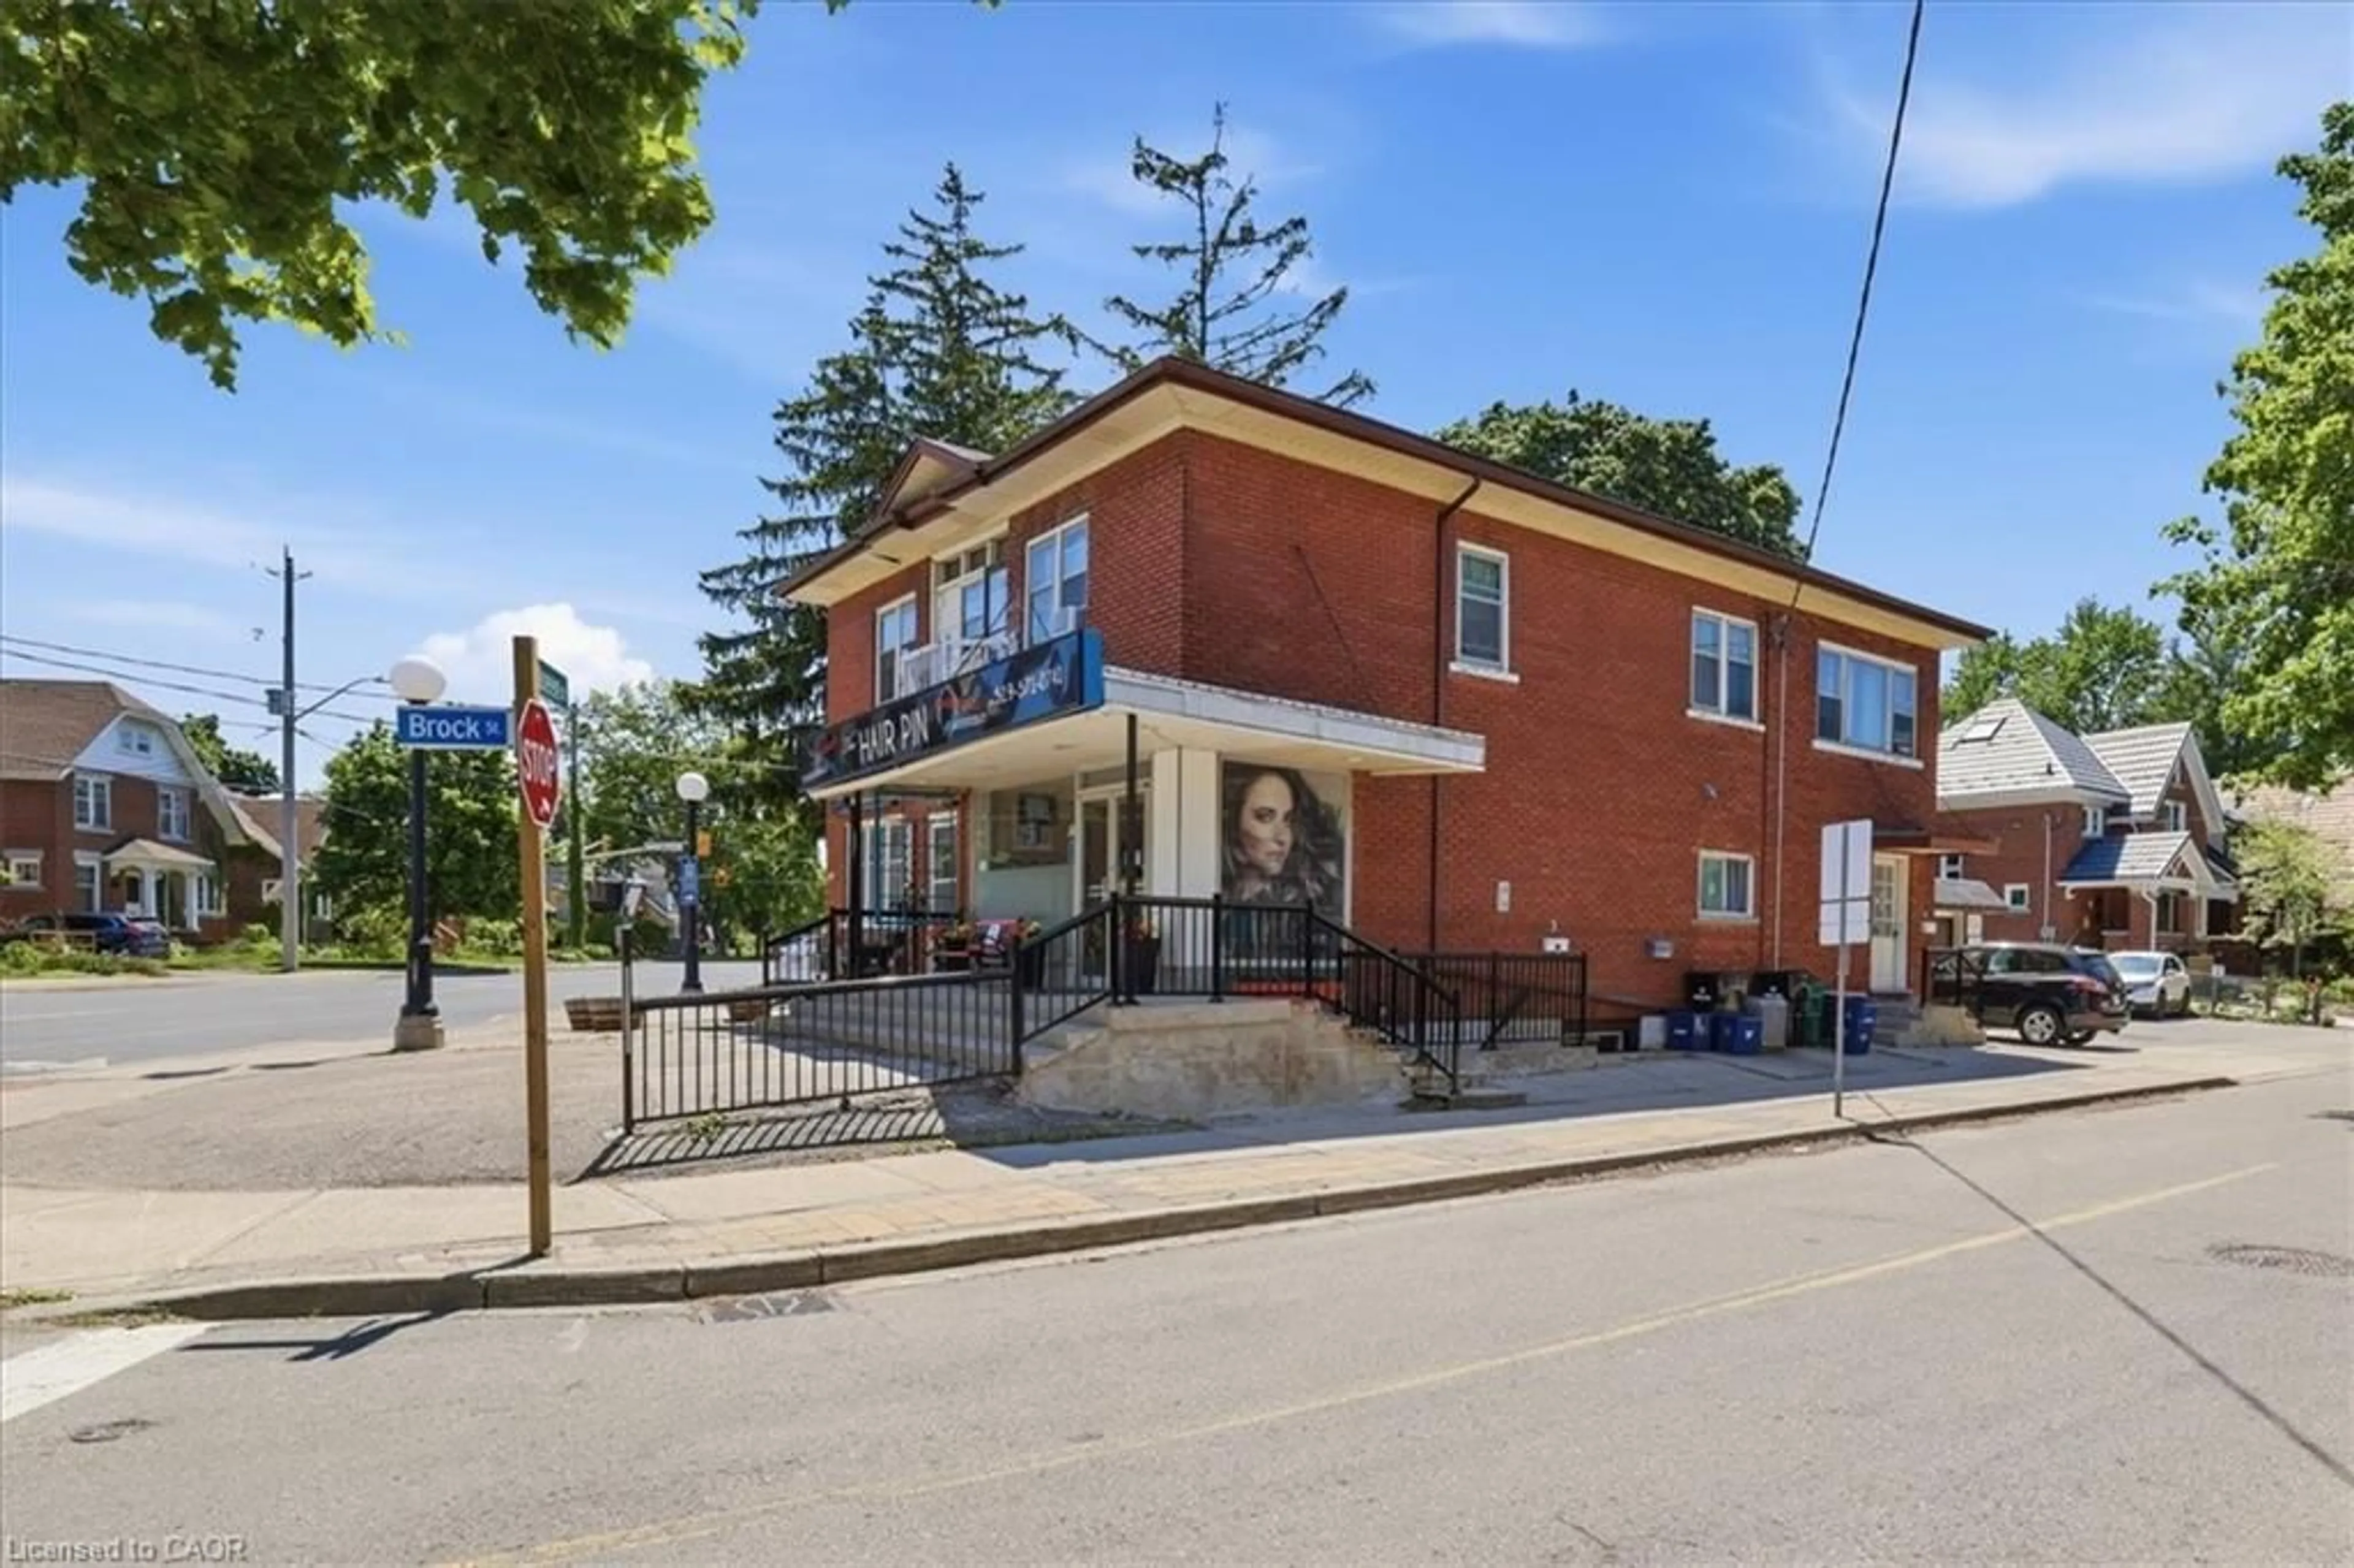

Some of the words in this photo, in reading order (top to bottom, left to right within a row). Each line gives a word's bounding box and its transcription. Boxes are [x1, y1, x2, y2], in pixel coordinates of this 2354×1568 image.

[408, 713, 481, 740] Brock
[858, 718, 896, 766] HAIR
[899, 703, 929, 751] PIN
[524, 737, 555, 789] STOP
